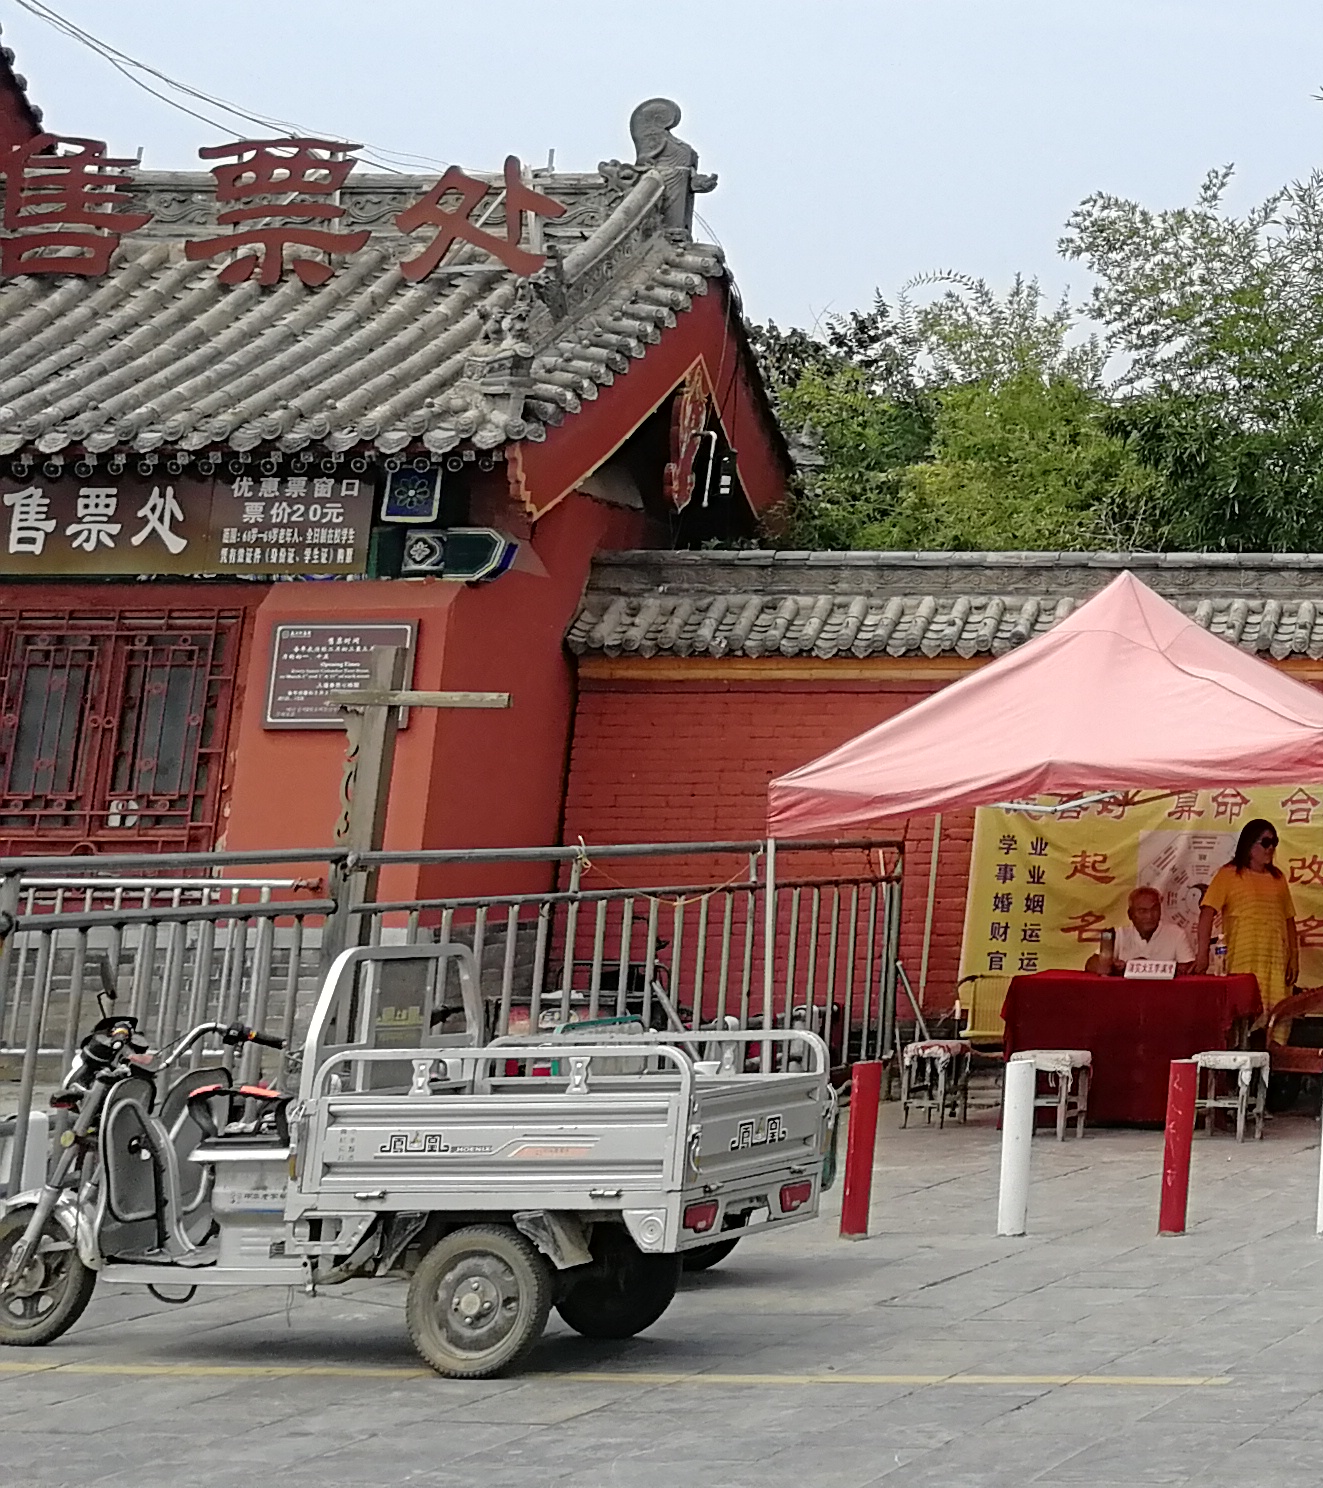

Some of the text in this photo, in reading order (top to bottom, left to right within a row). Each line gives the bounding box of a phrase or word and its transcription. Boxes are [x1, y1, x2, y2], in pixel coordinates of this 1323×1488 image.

[0, 132, 567, 288] 售票处
[231, 475, 360, 498] 优惠票窗口
[3, 485, 189, 555] 售票处
[242, 501, 345, 524] 票价20元
[998, 834, 1049, 857] 学业
[995, 864, 1046, 886] 事业
[992, 892, 1045, 914] 婚姻
[989, 922, 1041, 943] 财运
[986, 951, 1039, 972] 官运
